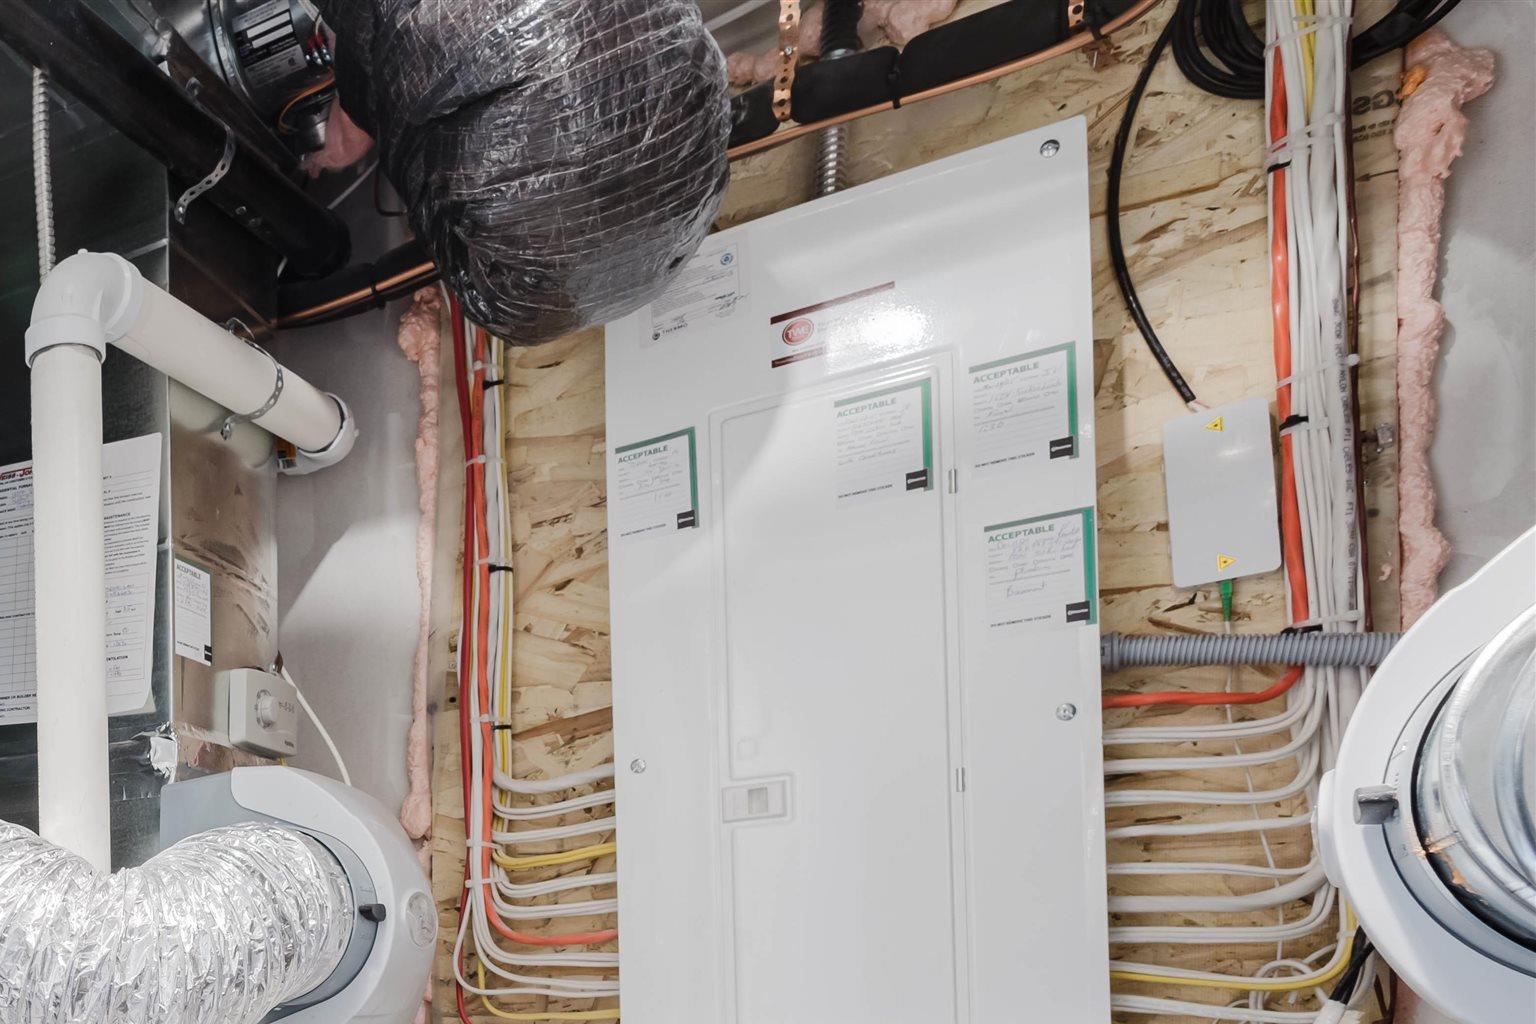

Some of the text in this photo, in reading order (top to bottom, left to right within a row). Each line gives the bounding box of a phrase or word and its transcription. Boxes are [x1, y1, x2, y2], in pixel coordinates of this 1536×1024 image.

[973, 362, 1039, 384] ACCEPTABLE
[837, 397, 897, 418] ACCEPTABLE
[618, 444, 669, 464] ACCEPTABLE
[988, 524, 1055, 543] ACCEPTABLE
[176, 563, 202, 581] ACCEPTABLE
